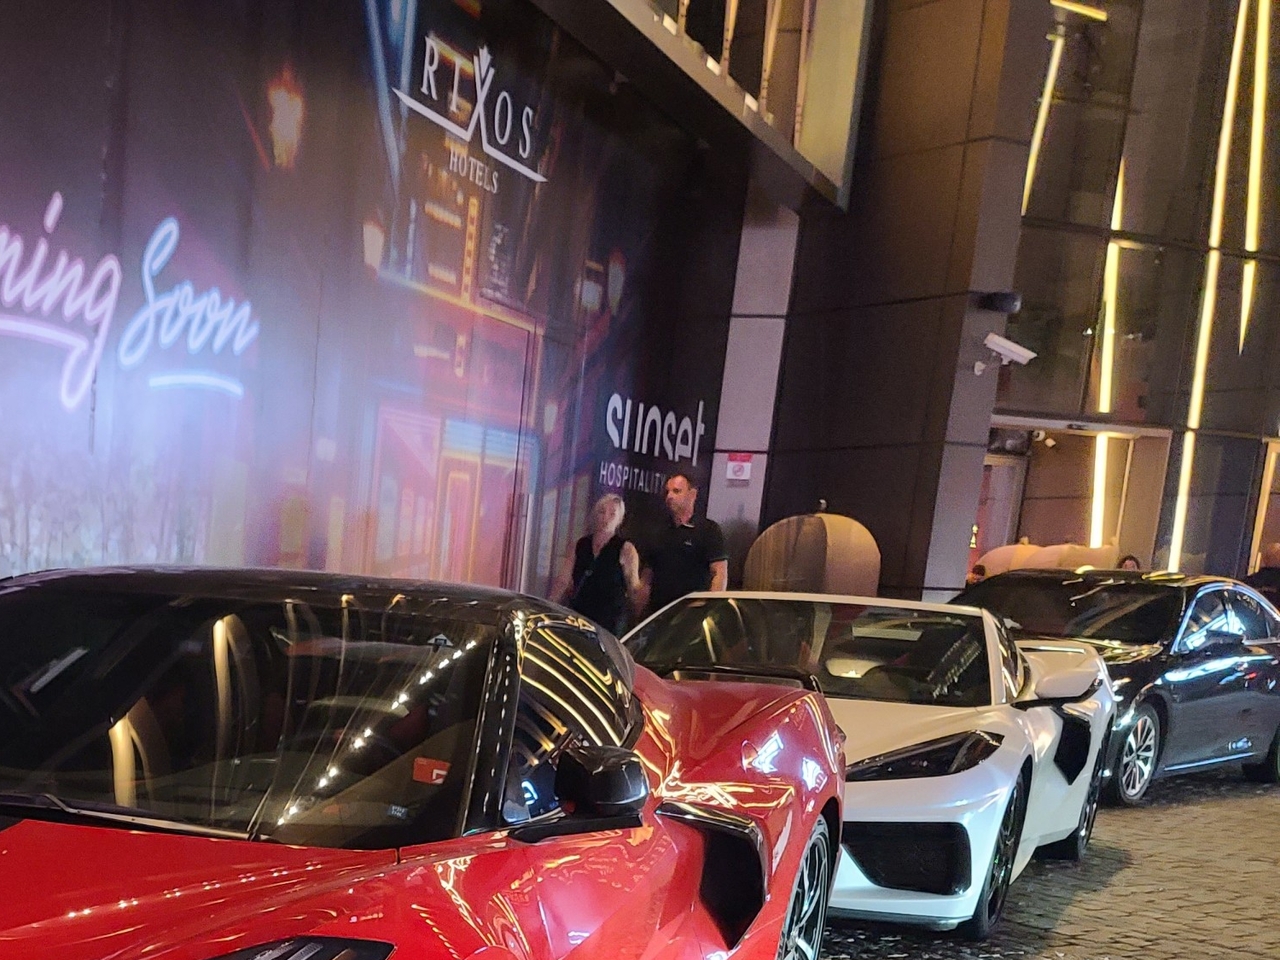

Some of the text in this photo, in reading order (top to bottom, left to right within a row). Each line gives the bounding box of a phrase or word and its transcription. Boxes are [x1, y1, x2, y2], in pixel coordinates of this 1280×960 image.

[418, 36, 535, 160] RIXOS
[449, 147, 499, 194] HOTELS
[120, 217, 259, 371] Soon
[599, 460, 665, 494] HOSPITALITY
